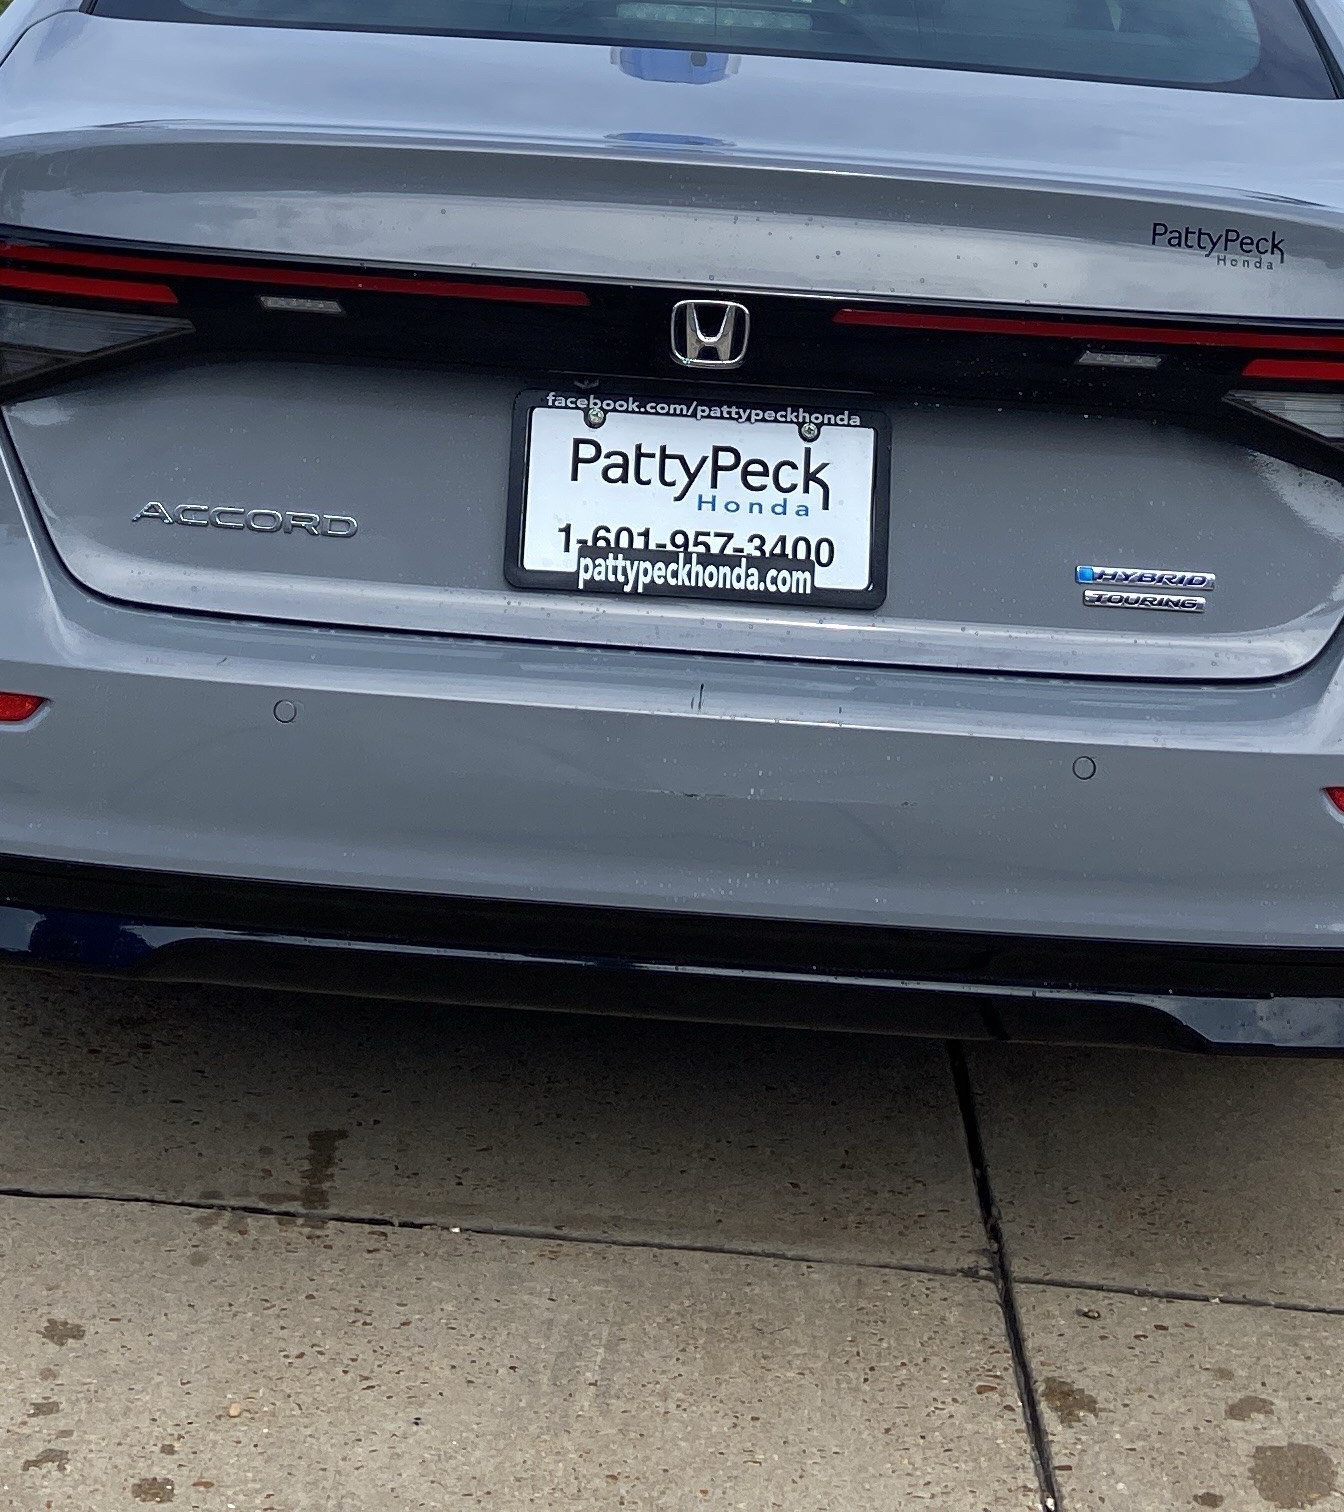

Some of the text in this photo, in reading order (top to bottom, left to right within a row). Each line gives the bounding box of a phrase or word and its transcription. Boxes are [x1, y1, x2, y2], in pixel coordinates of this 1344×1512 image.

[1151, 222, 1285, 264] PattyPeck
[1216, 254, 1274, 270] Honda
[547, 391, 861, 426] facebook.com/pattypeckhonda
[570, 437, 831, 511] PattyPeck
[132, 501, 359, 538] ACCORD
[696, 493, 810, 517] Honda
[558, 523, 835, 568] 1-601-957-3400
[577, 553, 812, 594] pattypeckhonda.com
[1096, 569, 1208, 587] HYBRID
[1092, 593, 1198, 609] TOURING
